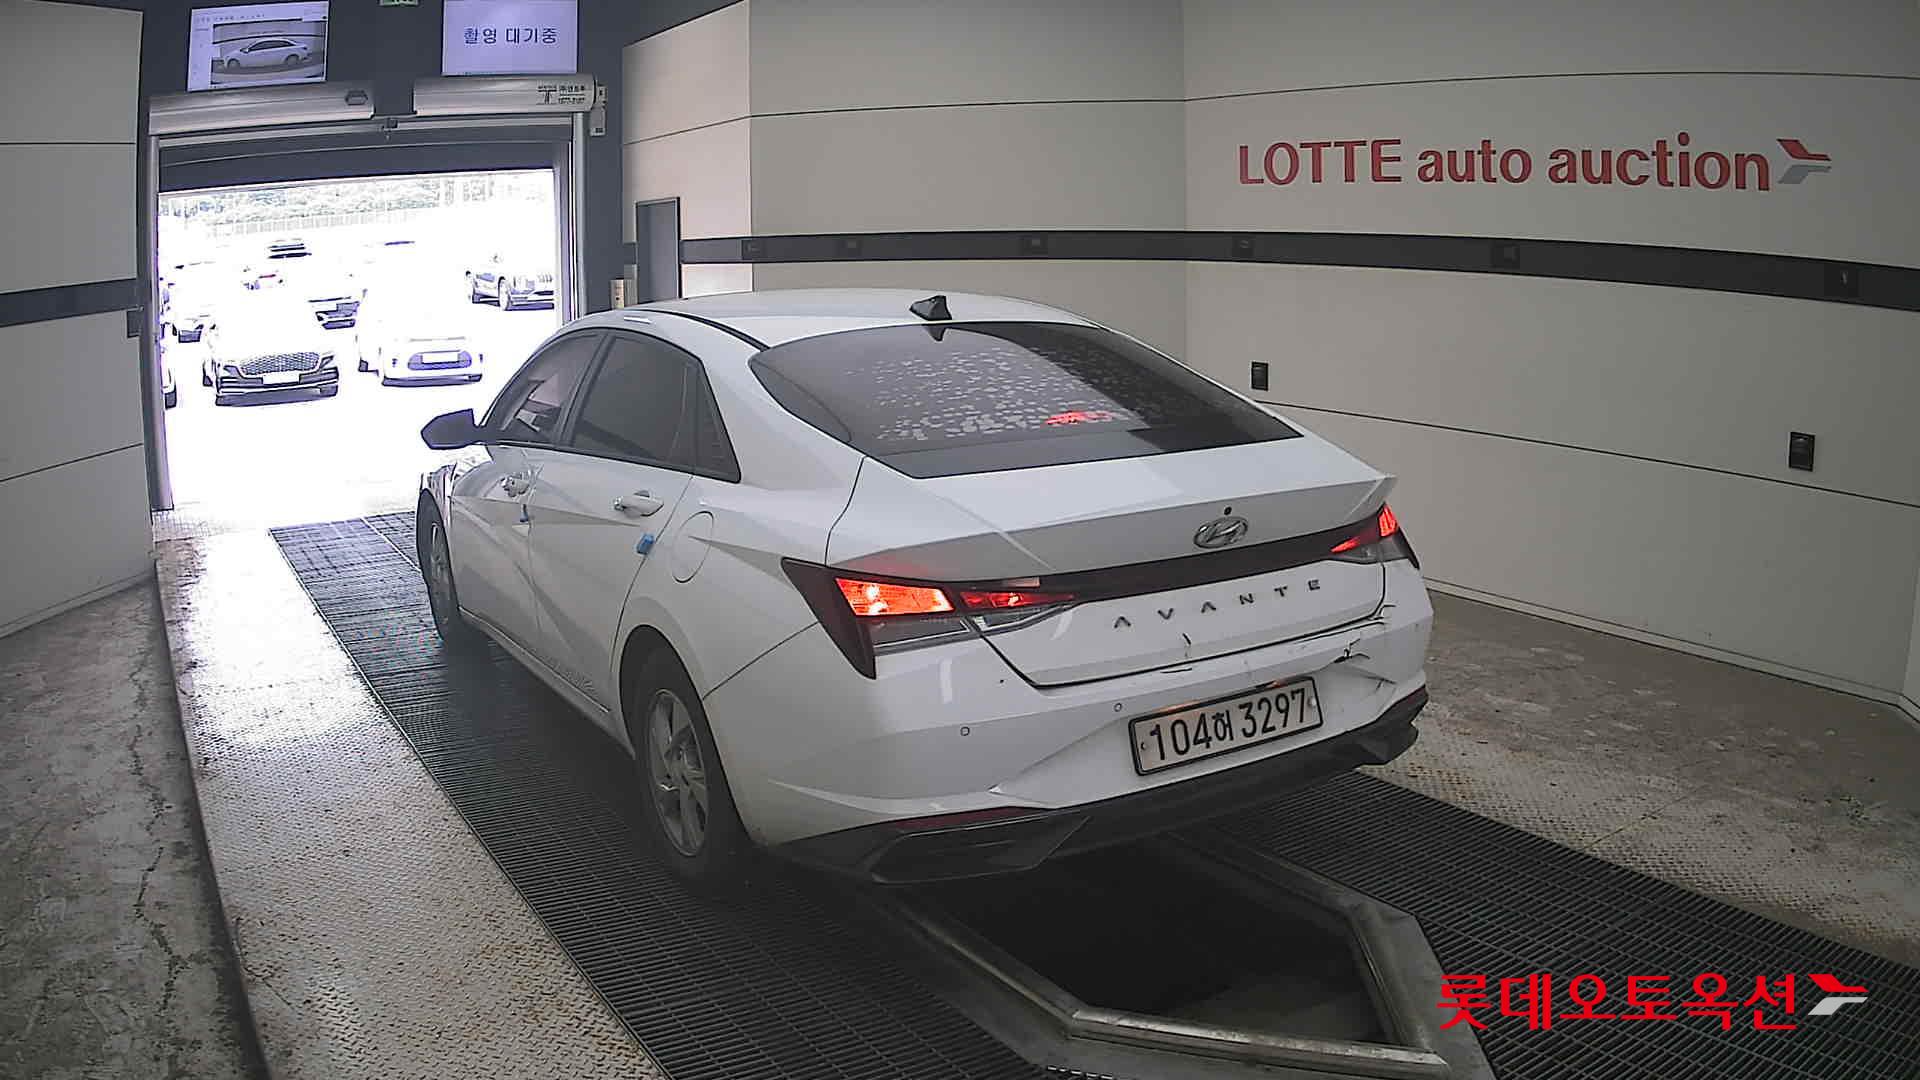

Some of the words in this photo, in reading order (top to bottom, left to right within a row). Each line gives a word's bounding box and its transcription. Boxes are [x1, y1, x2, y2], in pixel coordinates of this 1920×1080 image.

[505, 26, 558, 45] 대기중
[1238, 138, 1401, 185] LOTTE
[1416, 139, 1533, 183] auto
[1547, 132, 1770, 190] auction
[1113, 579, 1321, 629] AVANTE
[1238, 687, 1306, 738] 3297
